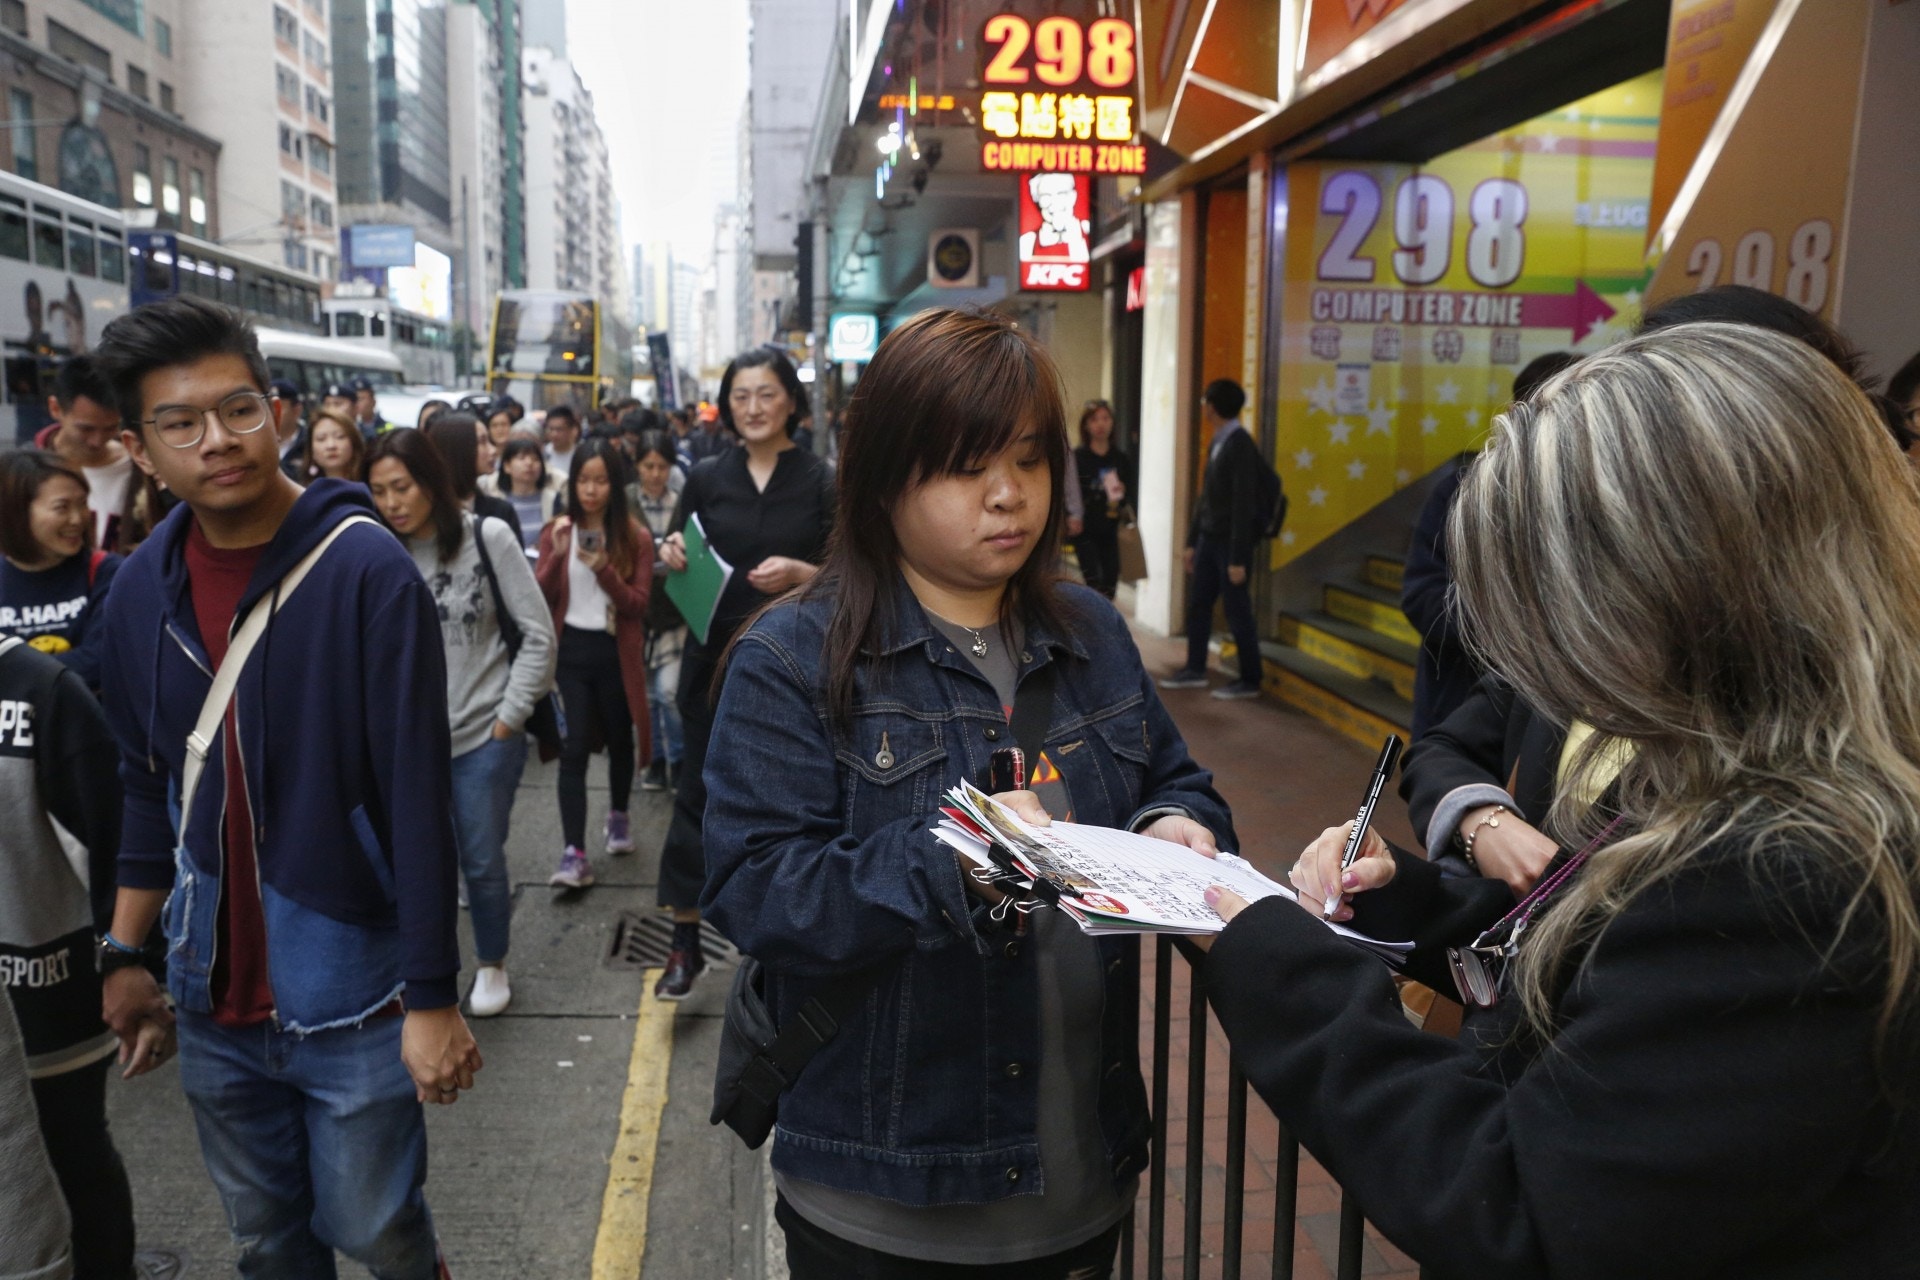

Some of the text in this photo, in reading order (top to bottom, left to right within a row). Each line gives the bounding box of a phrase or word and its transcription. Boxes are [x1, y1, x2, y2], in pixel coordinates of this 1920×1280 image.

[984, 14, 1135, 88] 298
[981, 91, 1133, 141] 電腦特區
[983, 142, 1147, 173] COMPUTER ZONE
[1316, 169, 1529, 288] 298
[1026, 264, 1085, 287] KFC
[1311, 289, 1523, 327] COMPUTER ZONE
[1349, 805, 1368, 840] MARKER
